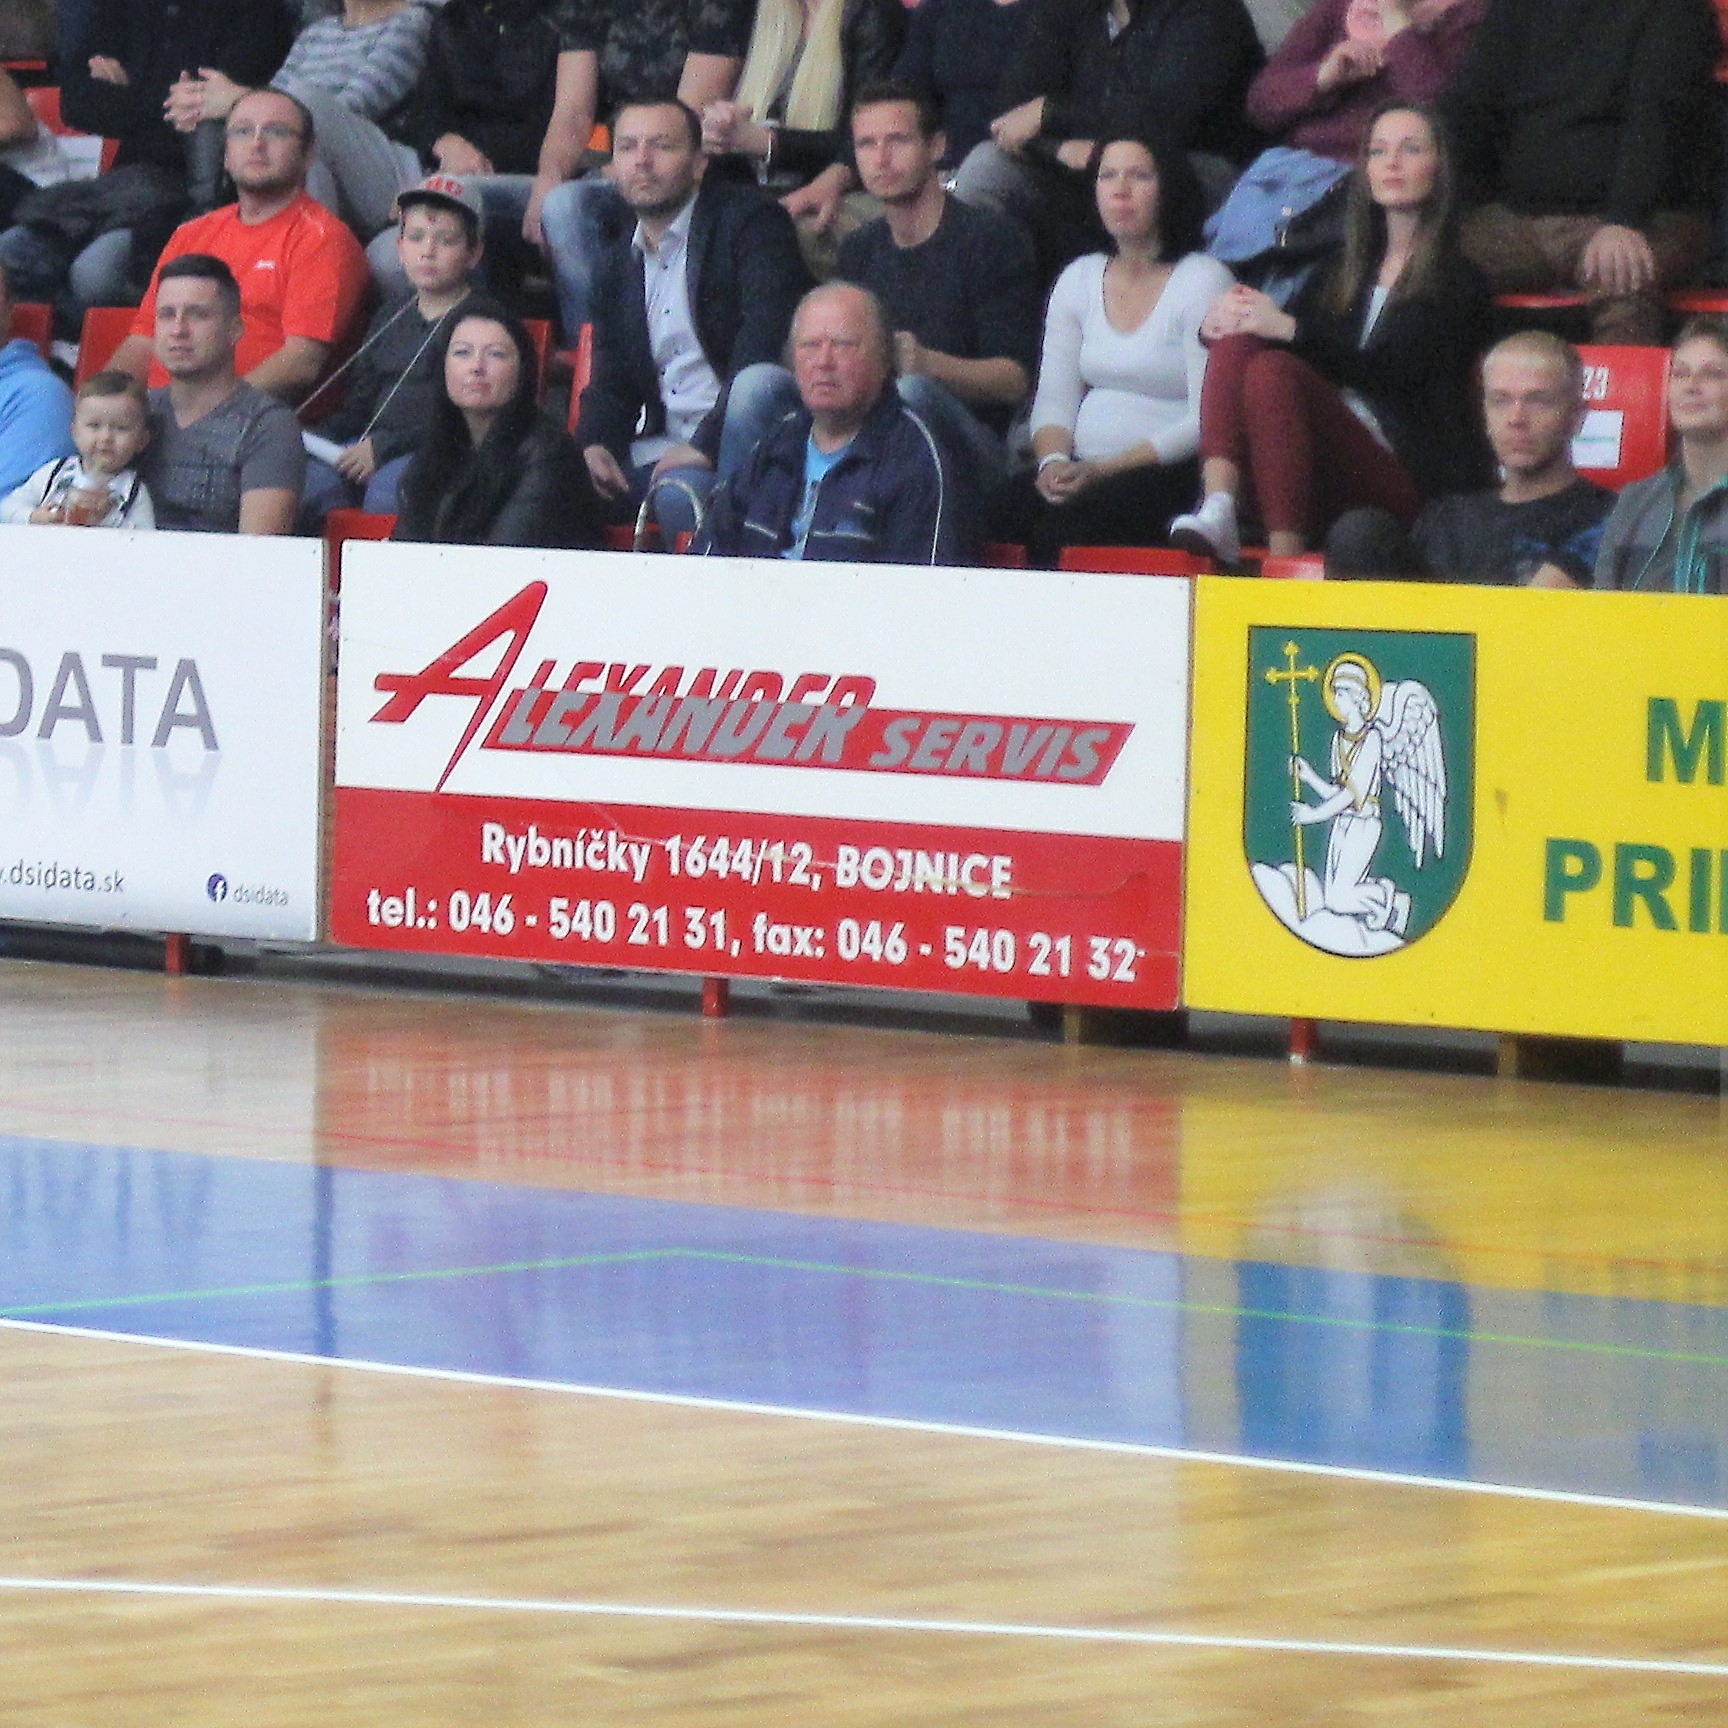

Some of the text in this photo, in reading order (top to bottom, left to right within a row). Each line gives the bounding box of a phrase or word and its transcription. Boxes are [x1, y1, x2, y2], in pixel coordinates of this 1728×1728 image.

[367, 578, 1112, 795] ALEXANDER SERVIS
[233, 883, 289, 907] dsidata
[480, 820, 1015, 901] Rybníčky 1644/12, BOJNICE
[1544, 836, 1728, 936] PRI
[366, 885, 440, 932] tel.:
[448, 889, 517, 938] 046
[547, 896, 617, 946] 540
[626, 901, 671, 948] 21
[683, 904, 742, 959] 31,
[752, 911, 827, 960] fax:
[836, 917, 910, 967] 046
[944, 925, 1017, 975] 540
[1027, 931, 1072, 978] 21
[1087, 935, 1139, 984] 32
